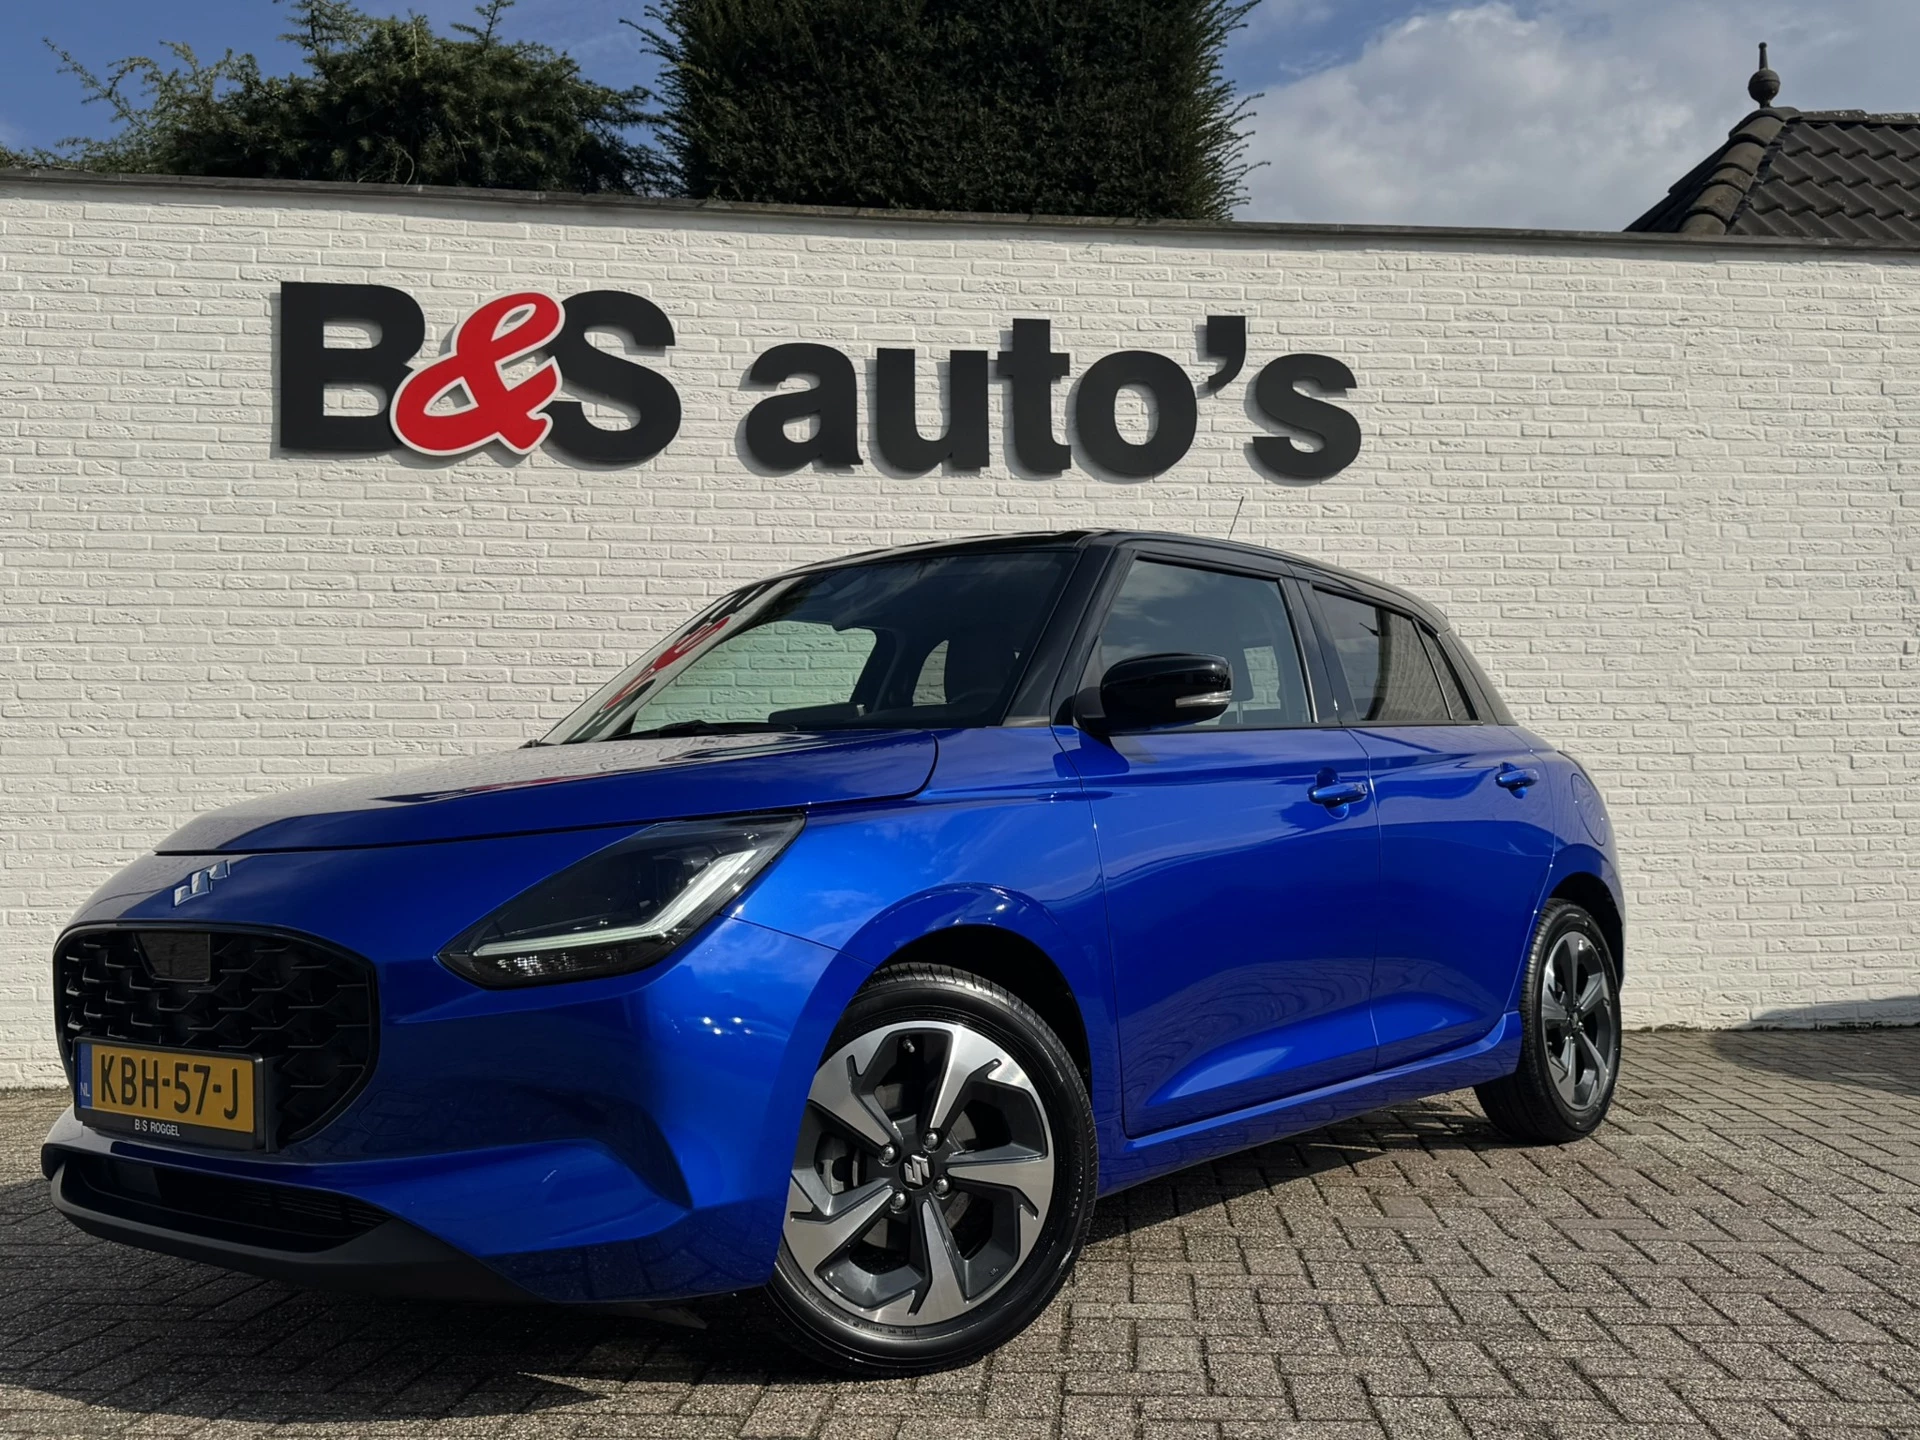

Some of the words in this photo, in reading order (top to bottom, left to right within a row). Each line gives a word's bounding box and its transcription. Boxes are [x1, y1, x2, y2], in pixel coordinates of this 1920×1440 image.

[280, 281, 681, 464] B&S
[746, 315, 1362, 478] auto's
[80, 1082, 91, 1097] NL
[101, 1054, 238, 1120] KBH-57-J
[150, 1121, 180, 1137] ROGGEL
